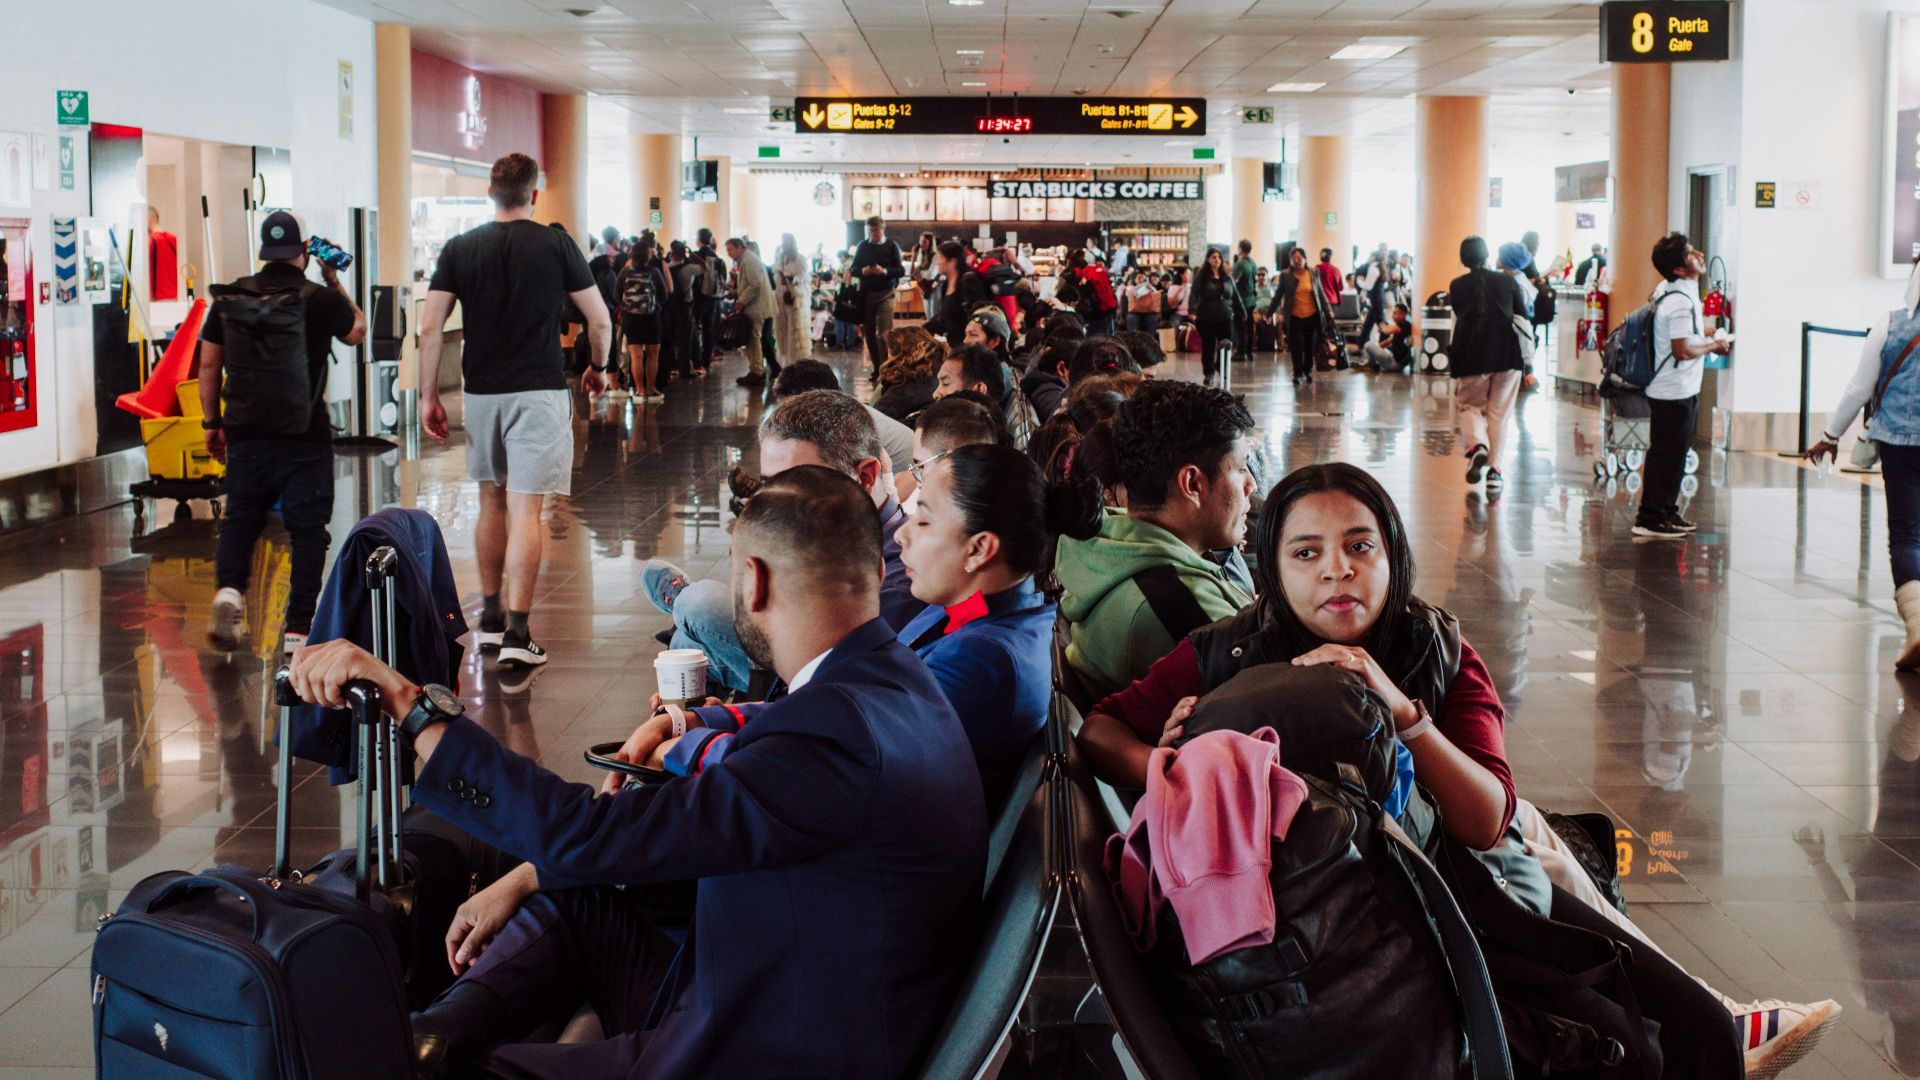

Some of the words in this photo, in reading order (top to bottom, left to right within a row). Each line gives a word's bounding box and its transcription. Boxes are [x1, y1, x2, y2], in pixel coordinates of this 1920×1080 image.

[1668, 16, 1710, 34] Puerta
[1631, 12, 1654, 54] 8
[1668, 37, 1693, 52] Gate
[853, 103, 887, 117] Puertas
[888, 104, 912, 116] 9-12
[1081, 103, 1116, 117] Puertas
[853, 118, 875, 130] Gates
[875, 118, 895, 130] 9-12
[978, 119, 1031, 131] 11:34:27
[1100, 118, 1122, 129] Gates
[992, 181, 1116, 198] STARBUCKS
[1119, 182, 1199, 198] COFFEE
[652, 212, 660, 222] S
